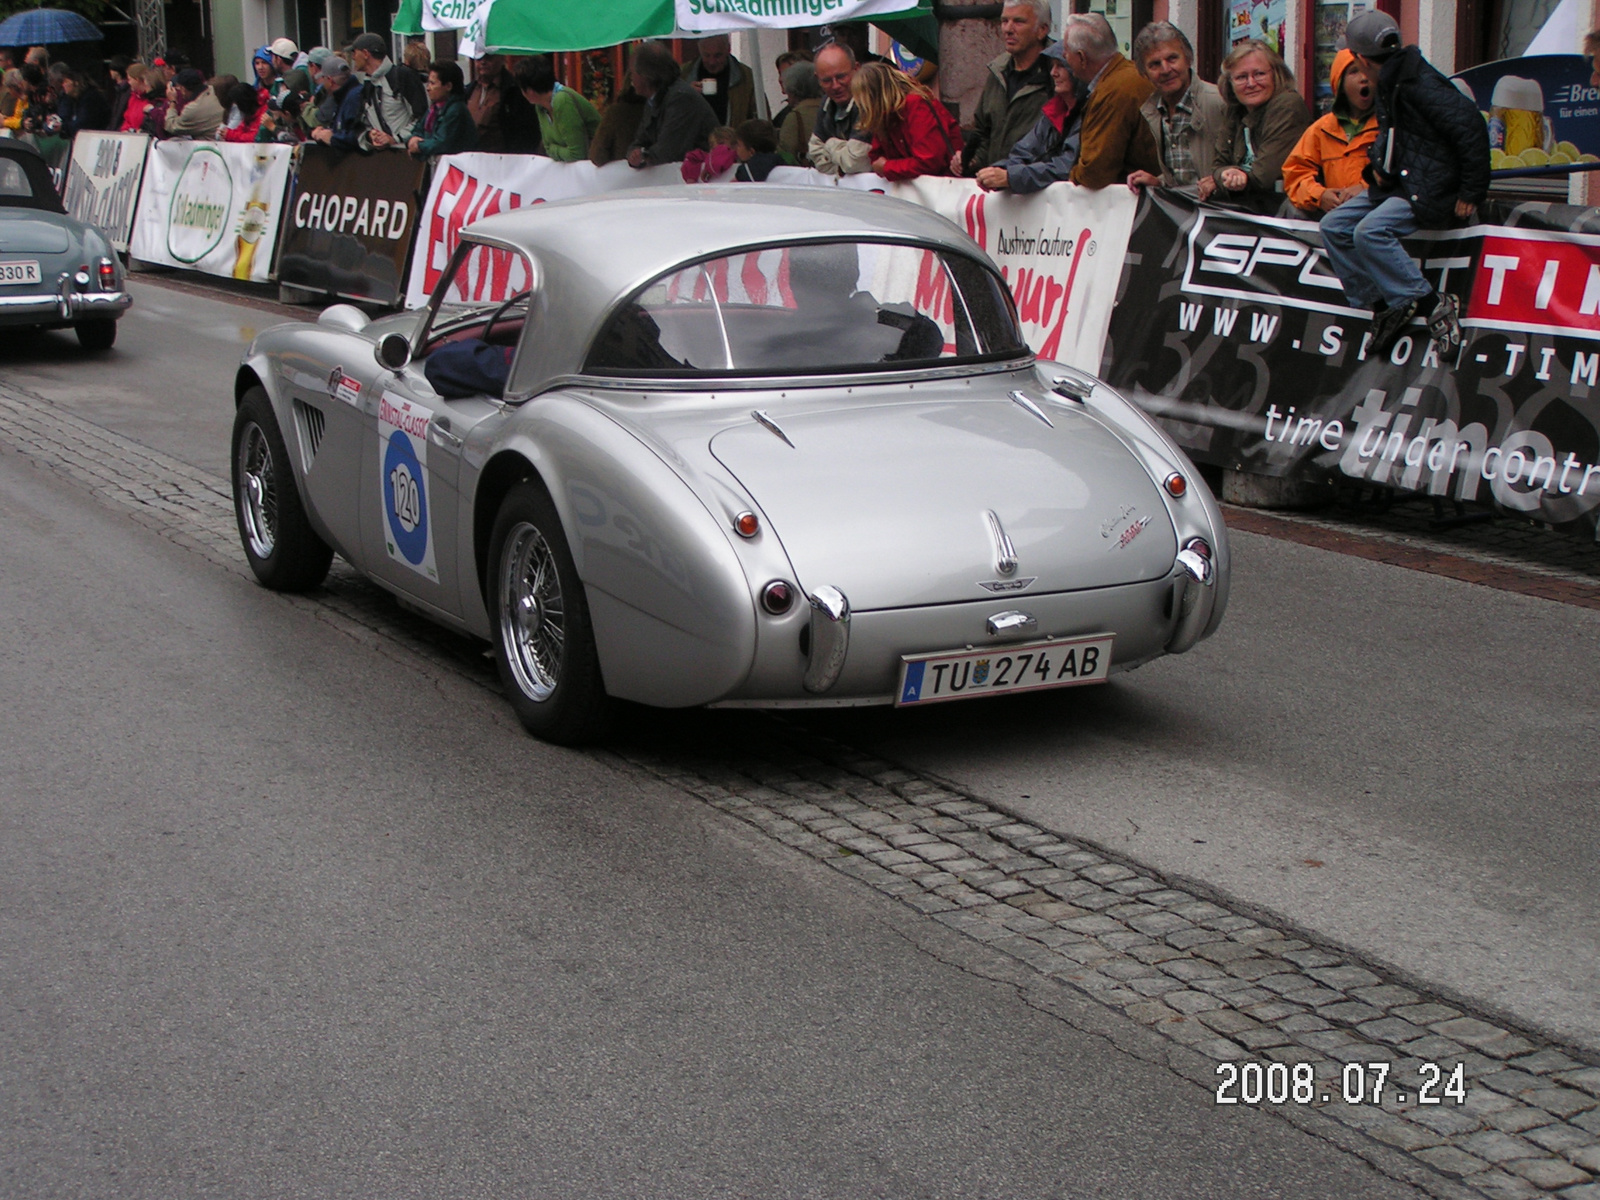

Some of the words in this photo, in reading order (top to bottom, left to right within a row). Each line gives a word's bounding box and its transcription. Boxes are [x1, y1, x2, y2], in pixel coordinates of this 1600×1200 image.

[1570, 84, 1600, 102] Bre
[295, 191, 408, 240] CHOPARD
[997, 226, 1035, 255] Austrian
[1036, 227, 1073, 256] Couture
[1200, 233, 1471, 294] SPT
[26, 266, 36, 279] R
[1263, 404, 1344, 450] time
[1358, 427, 1467, 473] under
[1481, 447, 1600, 496] contr
[390, 468, 420, 527] 120
[932, 661, 970, 694] TU
[992, 652, 1050, 687] 274
[1057, 646, 1100, 679] AB
